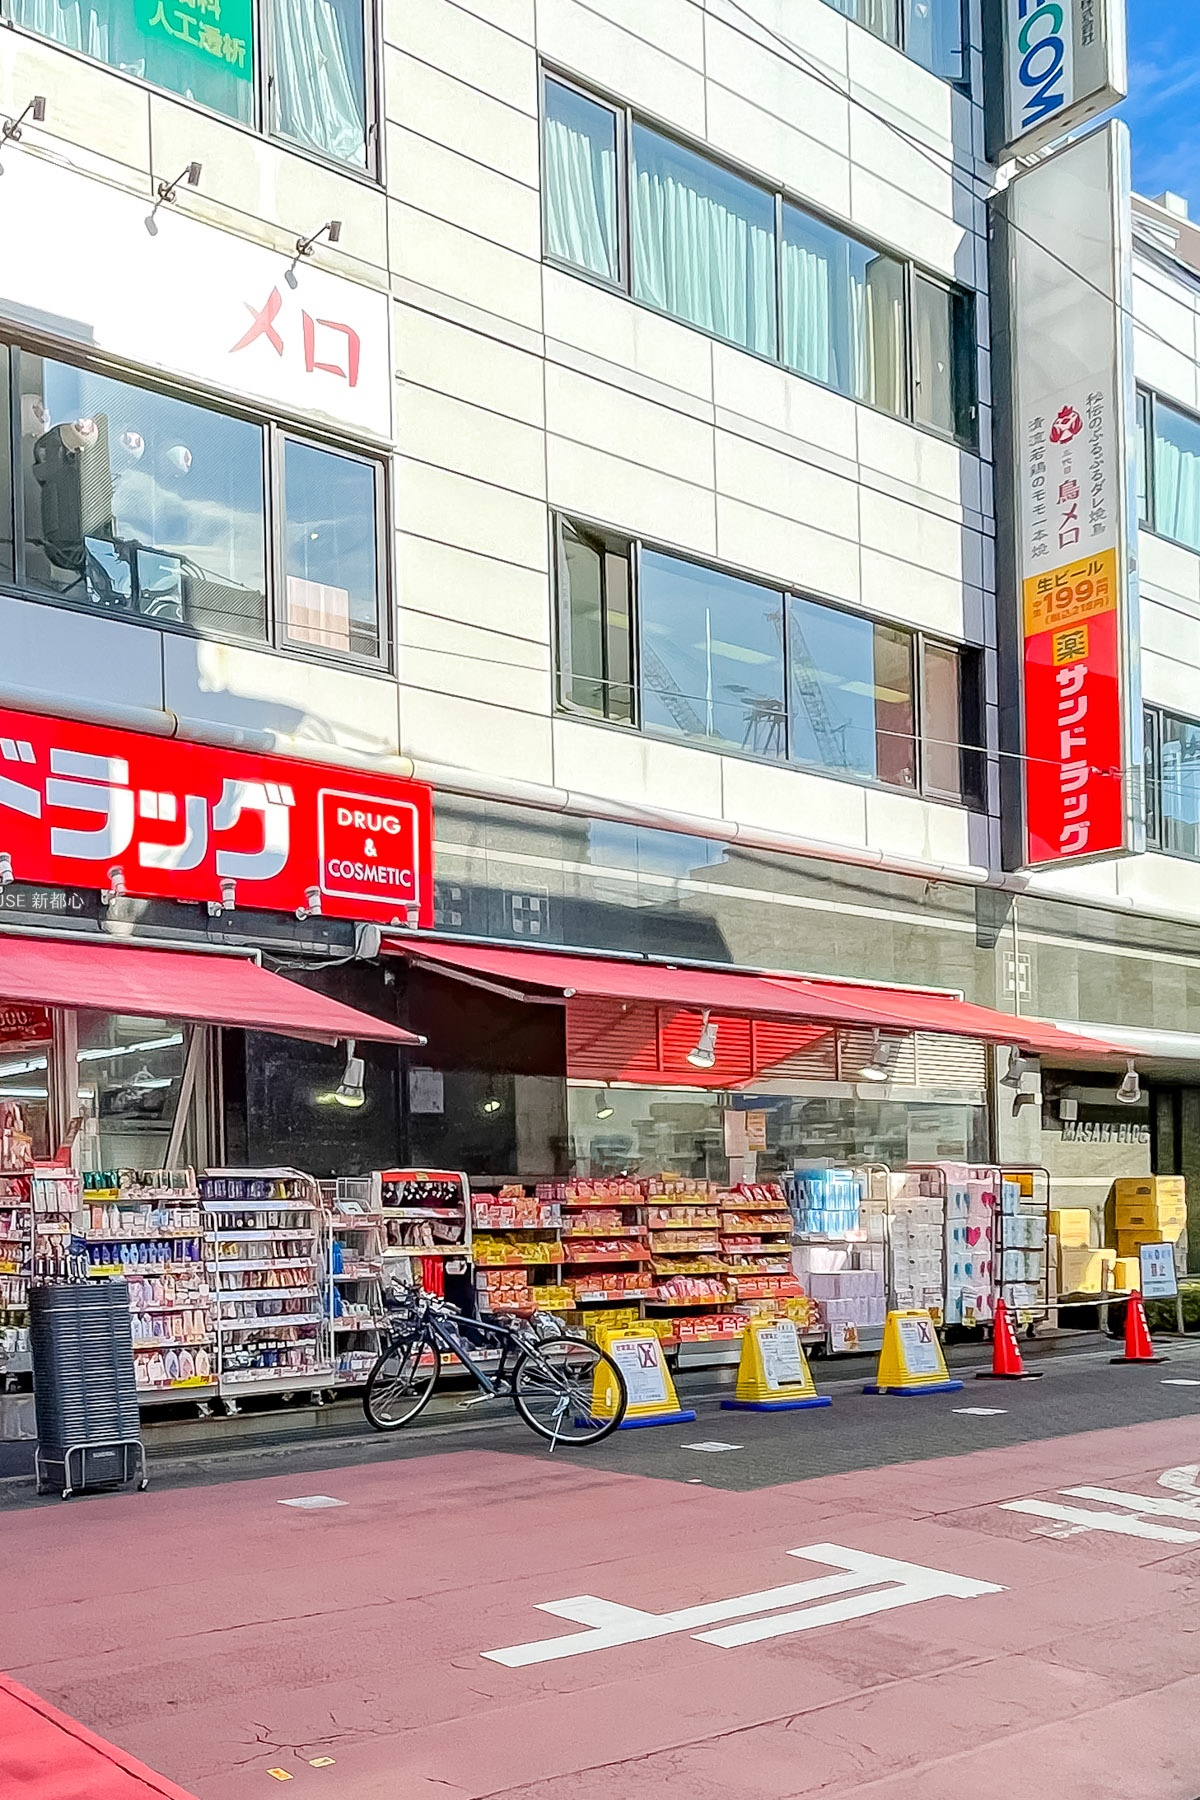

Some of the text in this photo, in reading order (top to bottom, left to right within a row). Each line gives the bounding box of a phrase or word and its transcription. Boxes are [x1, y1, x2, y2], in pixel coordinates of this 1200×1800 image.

[148, 1, 246, 68] 人工透析
[1018, 0, 1064, 128] COM
[228, 286, 361, 388] メロ
[1056, 479, 1080, 550] 鳥メロ
[1036, 560, 1105, 595] 生ビール
[1043, 579, 1094, 614] 199
[1055, 629, 1086, 663] 薬
[1055, 663, 1090, 854] サンドラッグ
[336, 807, 401, 835] DRUG
[363, 838, 378, 857] &
[327, 858, 412, 887] COSMETIC
